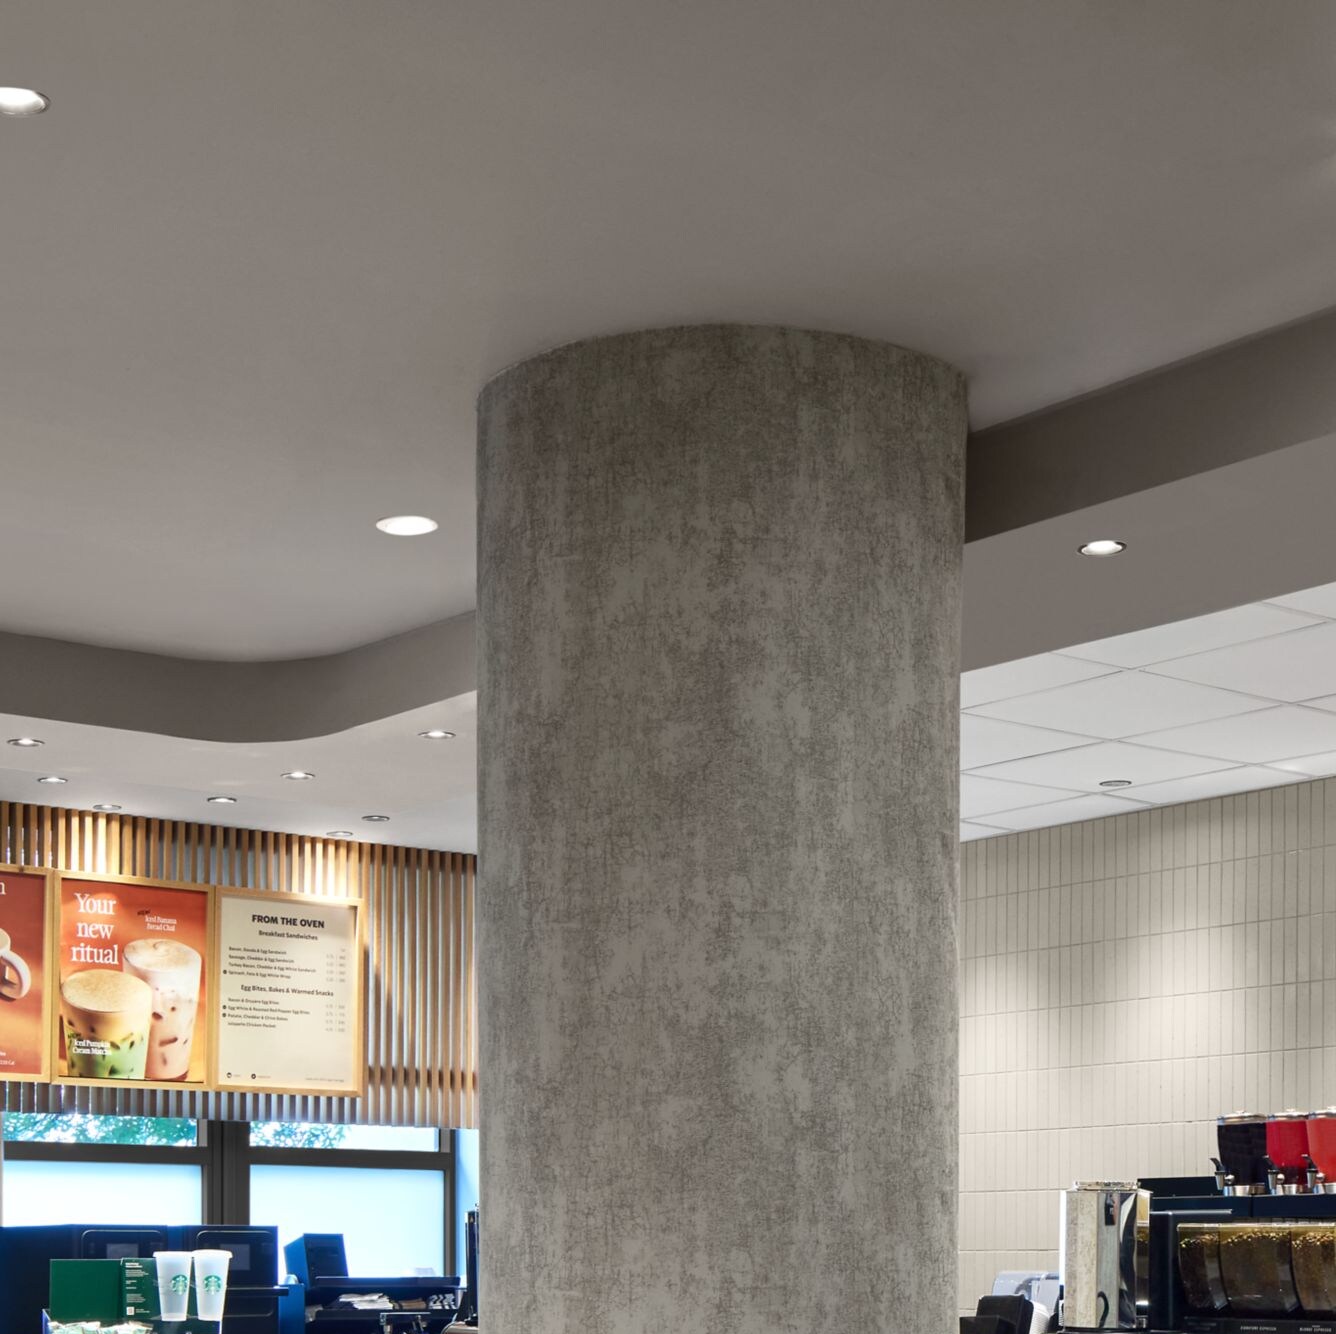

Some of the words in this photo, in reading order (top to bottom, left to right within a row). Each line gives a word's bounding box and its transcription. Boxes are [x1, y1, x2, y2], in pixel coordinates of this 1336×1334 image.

[74, 892, 117, 915] Your
[252, 914, 278, 925] FROM
[280, 917, 297, 926] THE
[300, 918, 325, 928] OVEN
[77, 922, 115, 939] new
[258, 930, 285, 938] Breakfast
[286, 932, 318, 940] Sandwiches
[71, 943, 119, 965] ritual
[241, 984, 251, 992] Egg
[315, 989, 334, 997] Snacks
